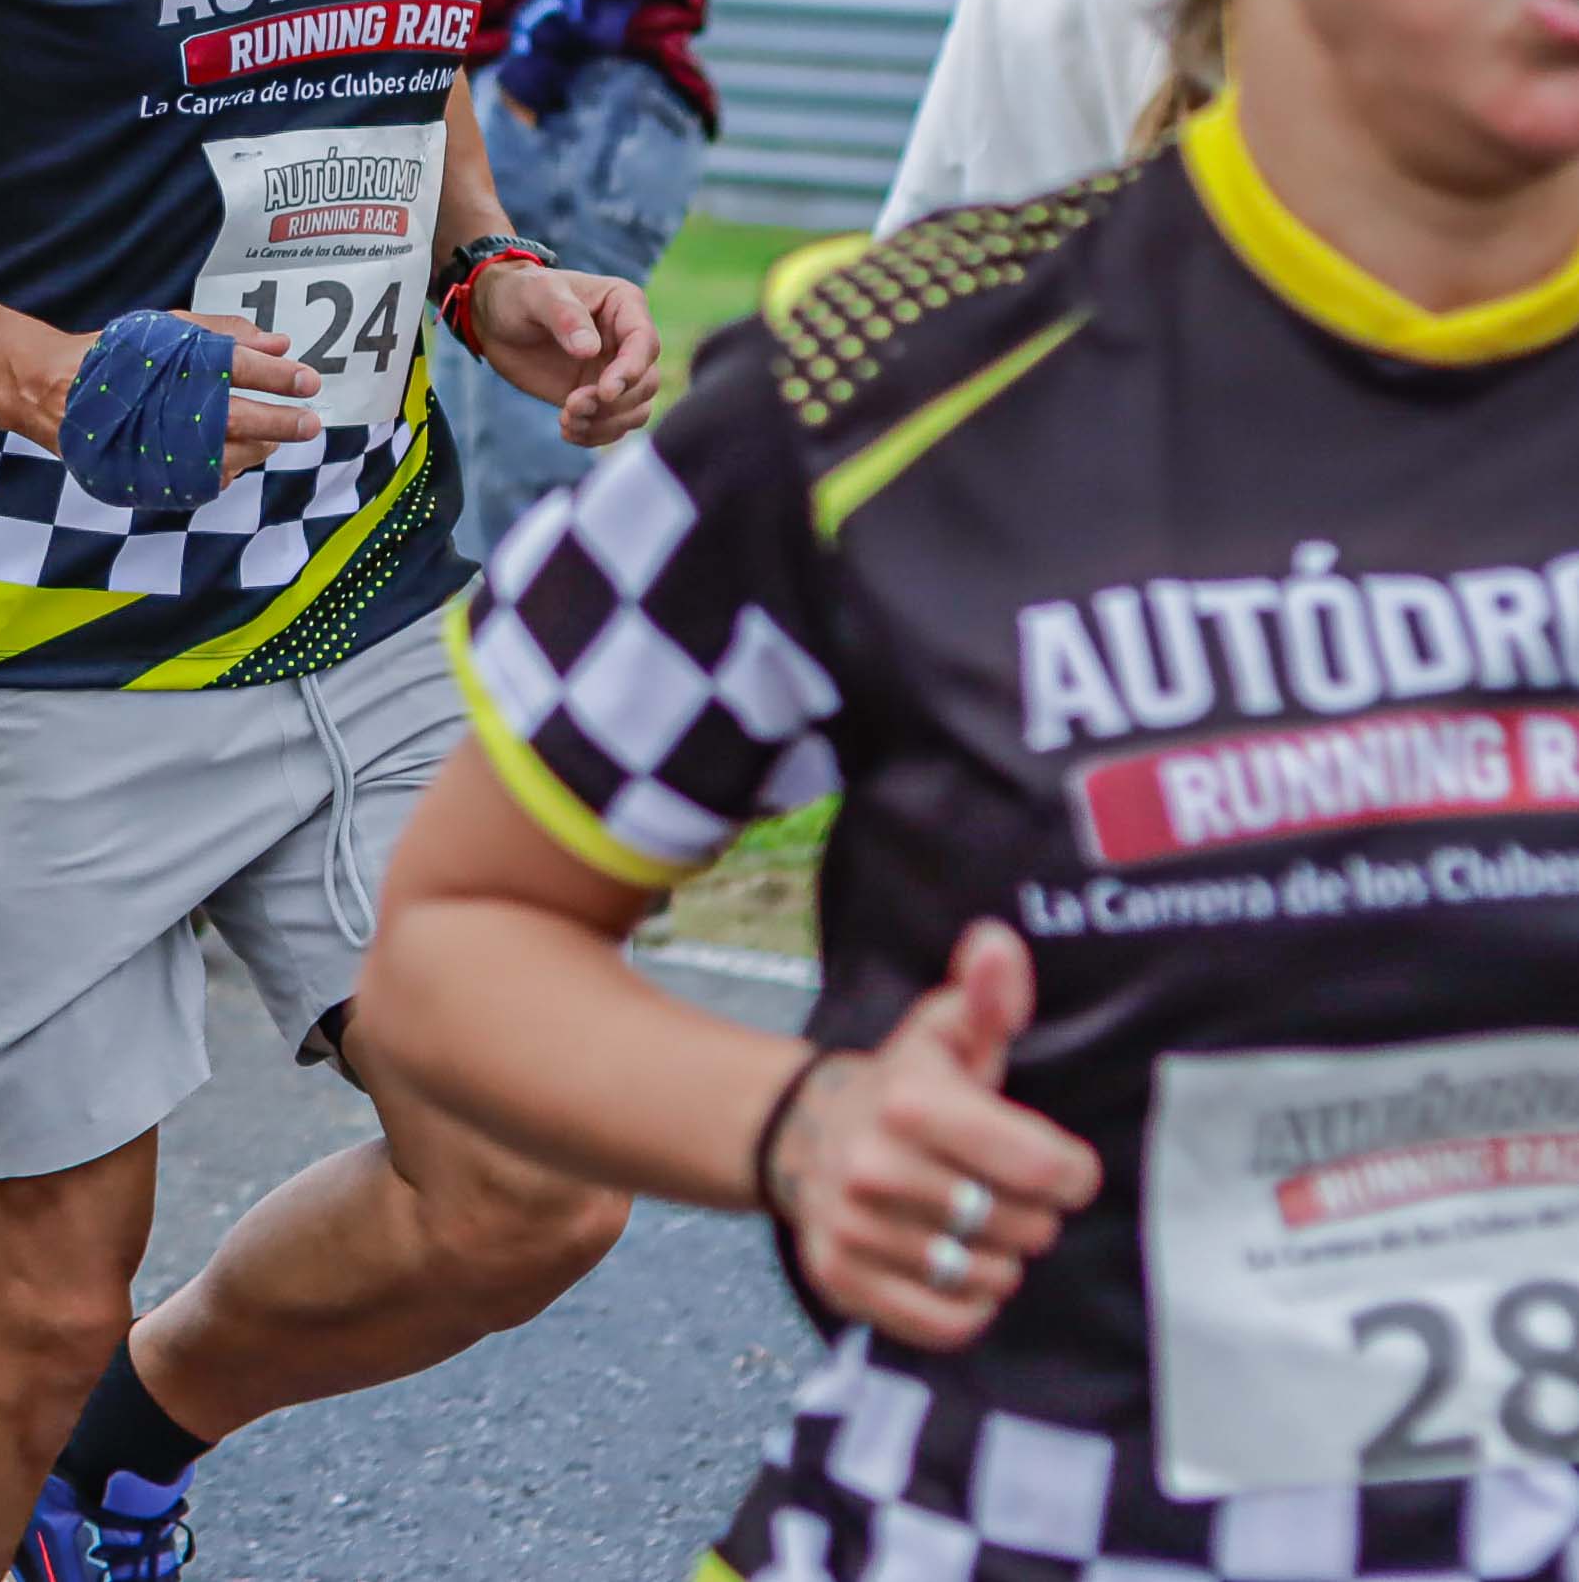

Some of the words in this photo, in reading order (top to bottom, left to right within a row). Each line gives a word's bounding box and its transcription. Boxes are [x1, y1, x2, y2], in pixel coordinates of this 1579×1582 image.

[229, 11, 387, 74] RUNNING
[392, 3, 475, 51] RACE
[139, 95, 169, 119] La
[260, 80, 288, 103] de
[293, 77, 325, 101] los
[330, 71, 405, 99] Clubes
[408, 68, 438, 92] del
[263, 146, 423, 213] AUTÓDROMO
[245, 247, 258, 259] La
[260, 246, 297, 259] Carrera
[300, 245, 314, 258] de
[315, 244, 331, 257] los
[287, 209, 360, 237] RUNNING
[362, 208, 400, 234] RACE
[241, 278, 403, 375] 124
[1016, 538, 1579, 754] AUTÓDR
[1157, 714, 1513, 846] RUNNING
